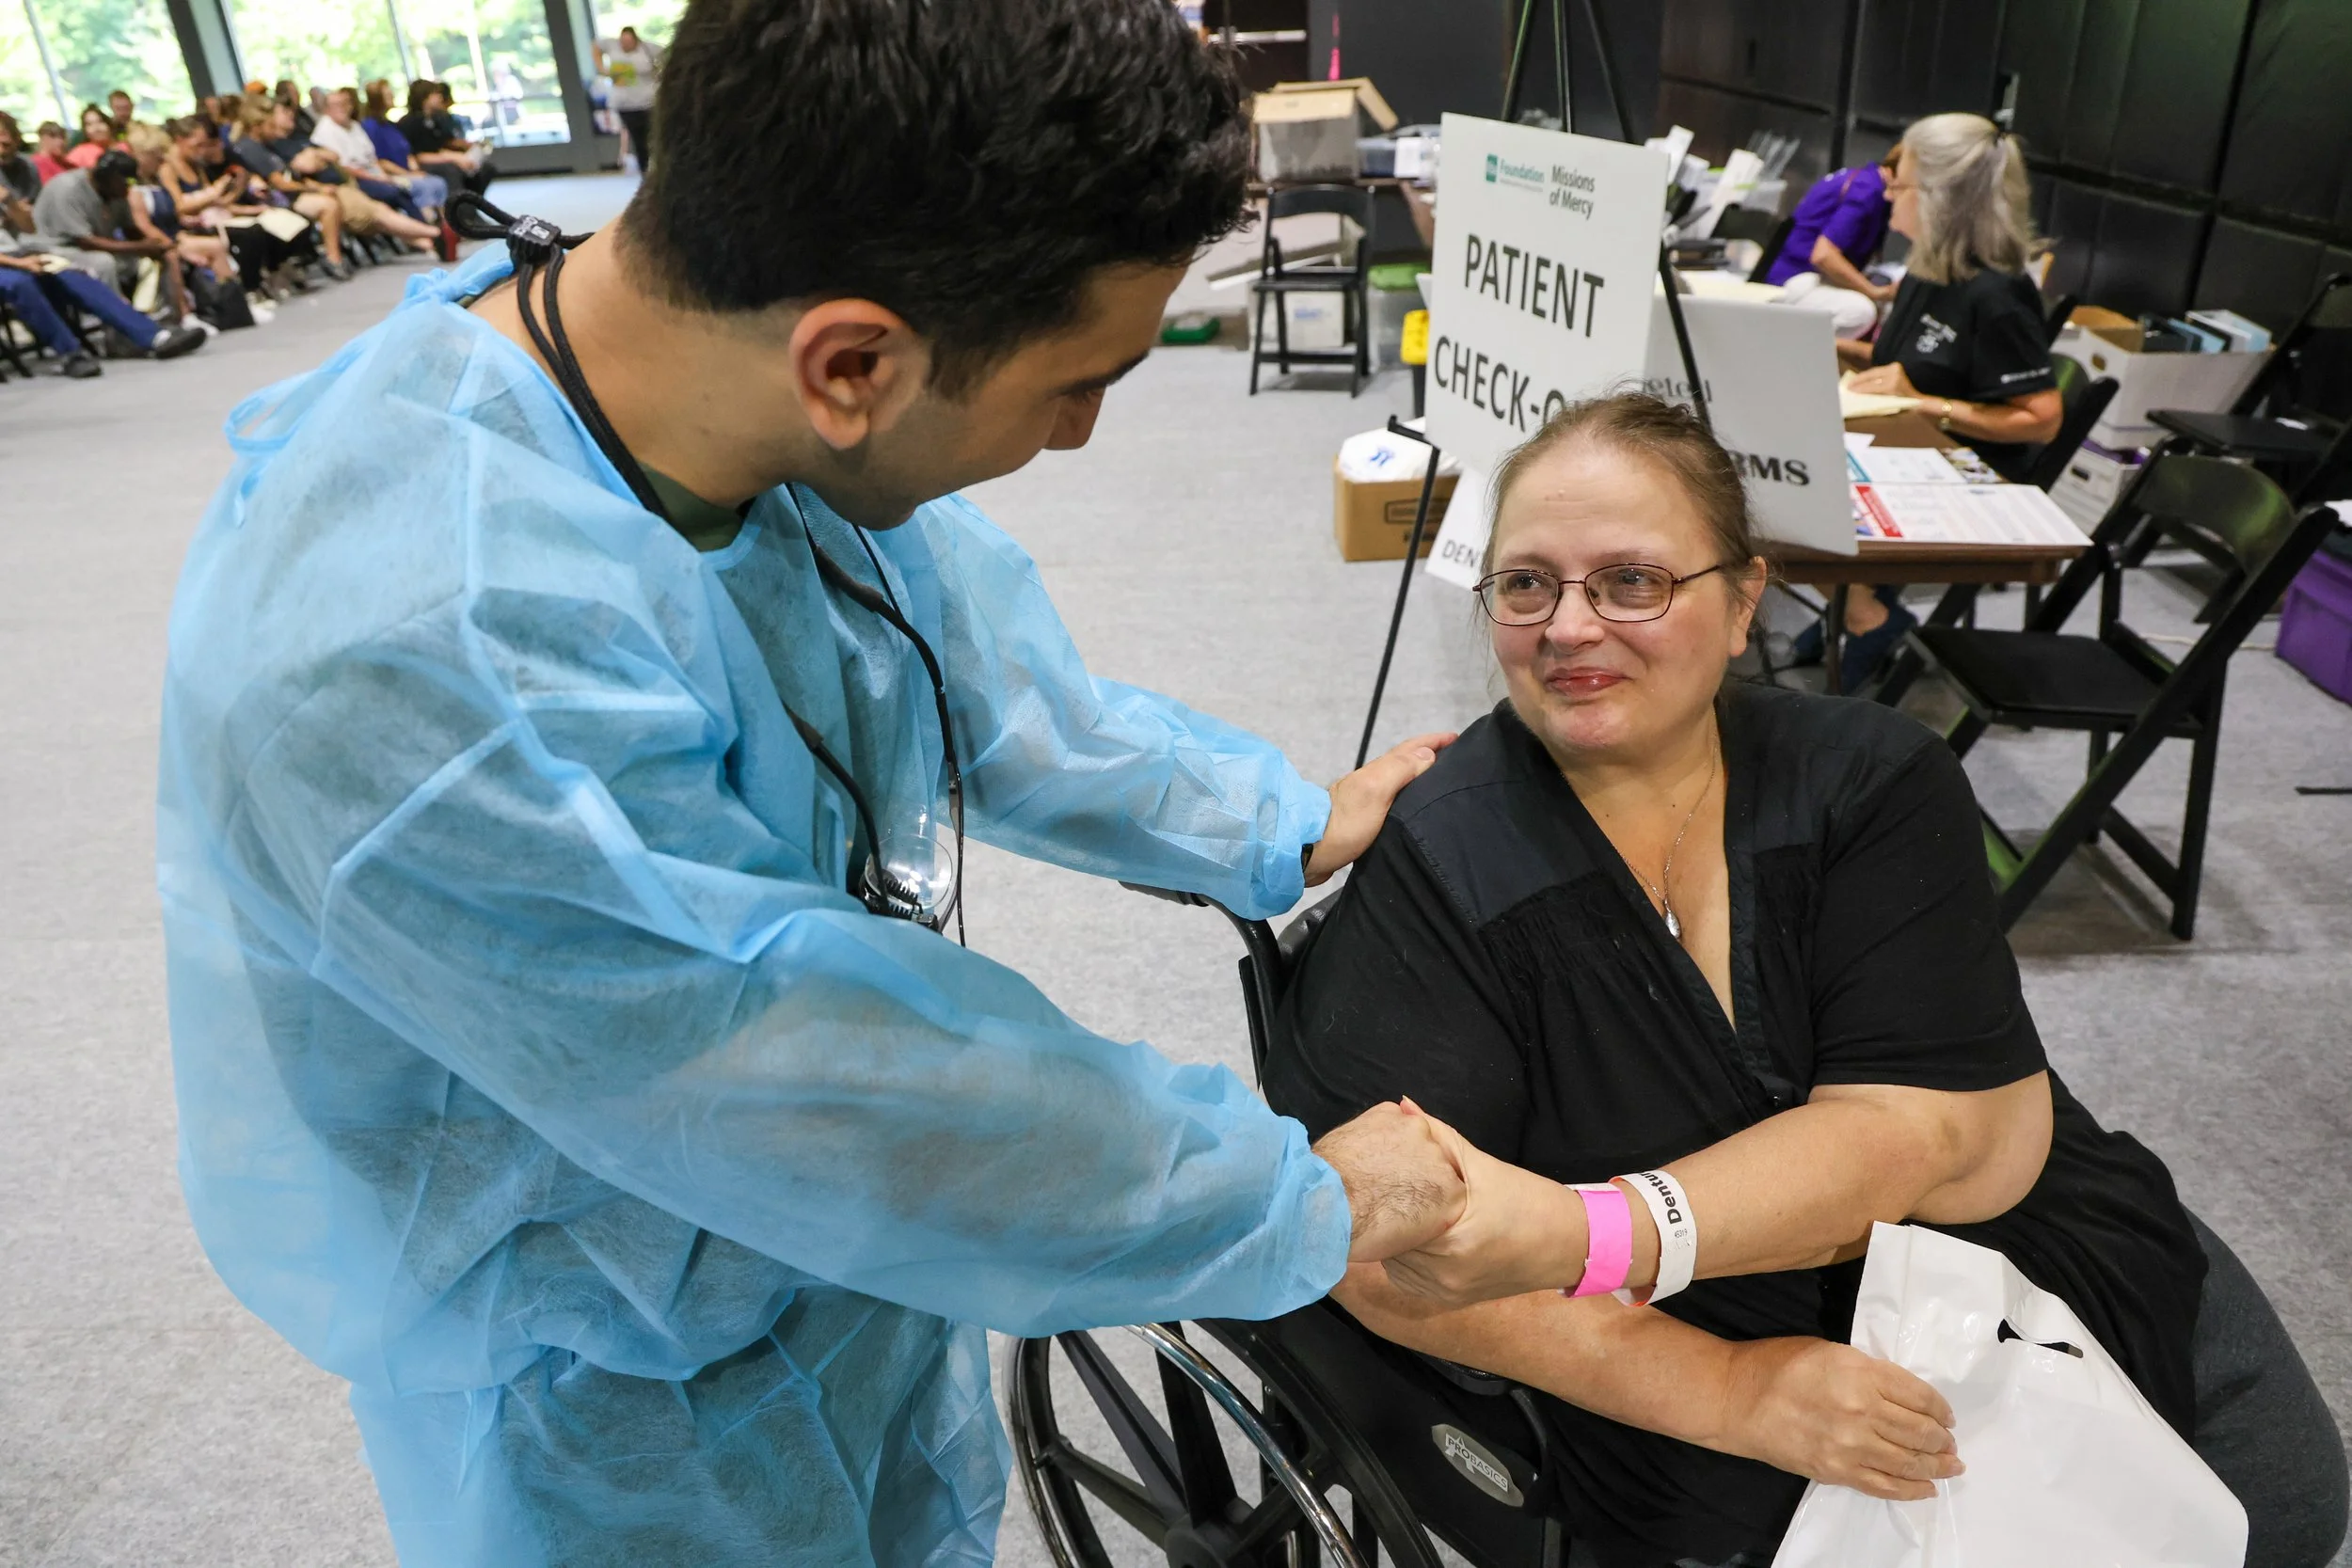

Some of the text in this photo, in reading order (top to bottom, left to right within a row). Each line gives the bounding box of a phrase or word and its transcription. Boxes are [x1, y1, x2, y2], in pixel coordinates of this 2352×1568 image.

[1551, 164, 1596, 193] Missions
[1549, 187, 1594, 221] of Mercy
[1464, 233, 1605, 339] PATIENT
[1448, 1437, 1507, 1488] PROBASICS
